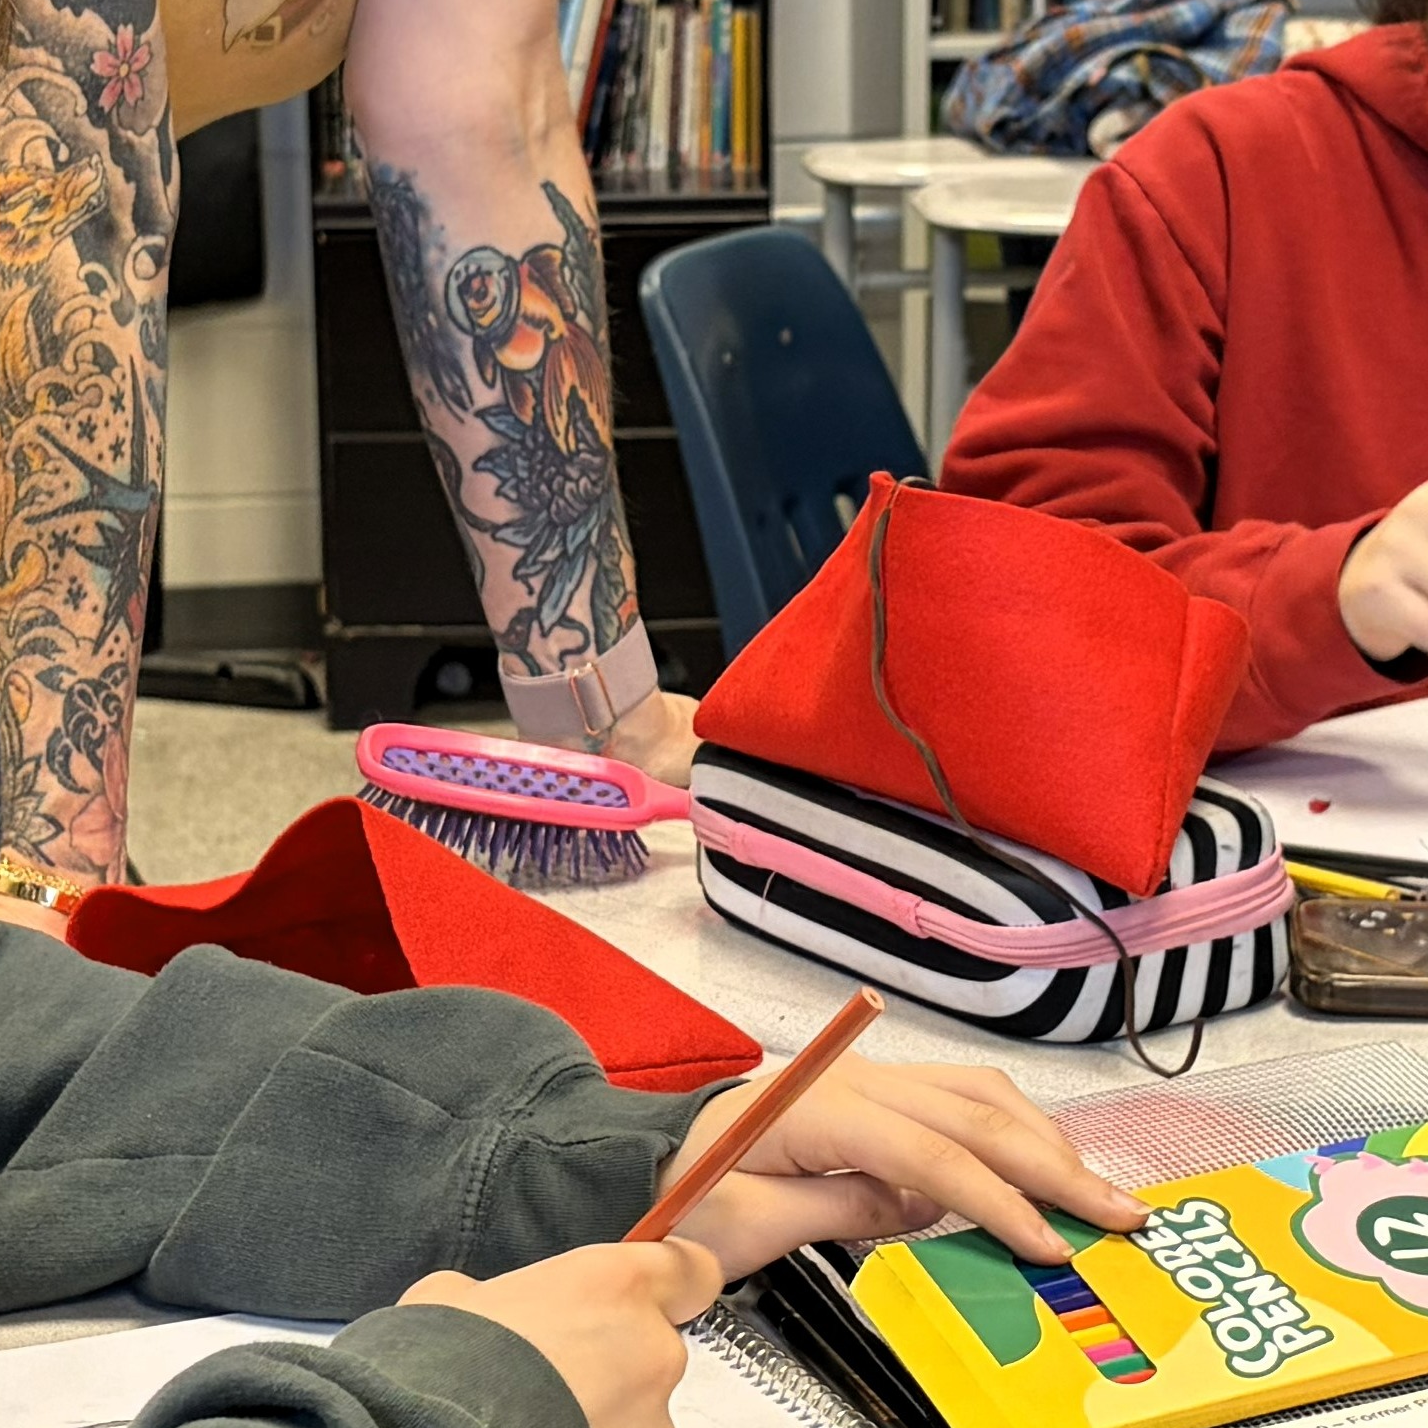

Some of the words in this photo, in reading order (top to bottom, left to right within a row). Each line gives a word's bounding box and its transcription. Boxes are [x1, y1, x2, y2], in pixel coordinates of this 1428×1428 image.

[1129, 1213, 1280, 1374] COLORE
[1162, 1200, 1328, 1355] PENCILS
[1344, 1404, 1411, 1425] Former
